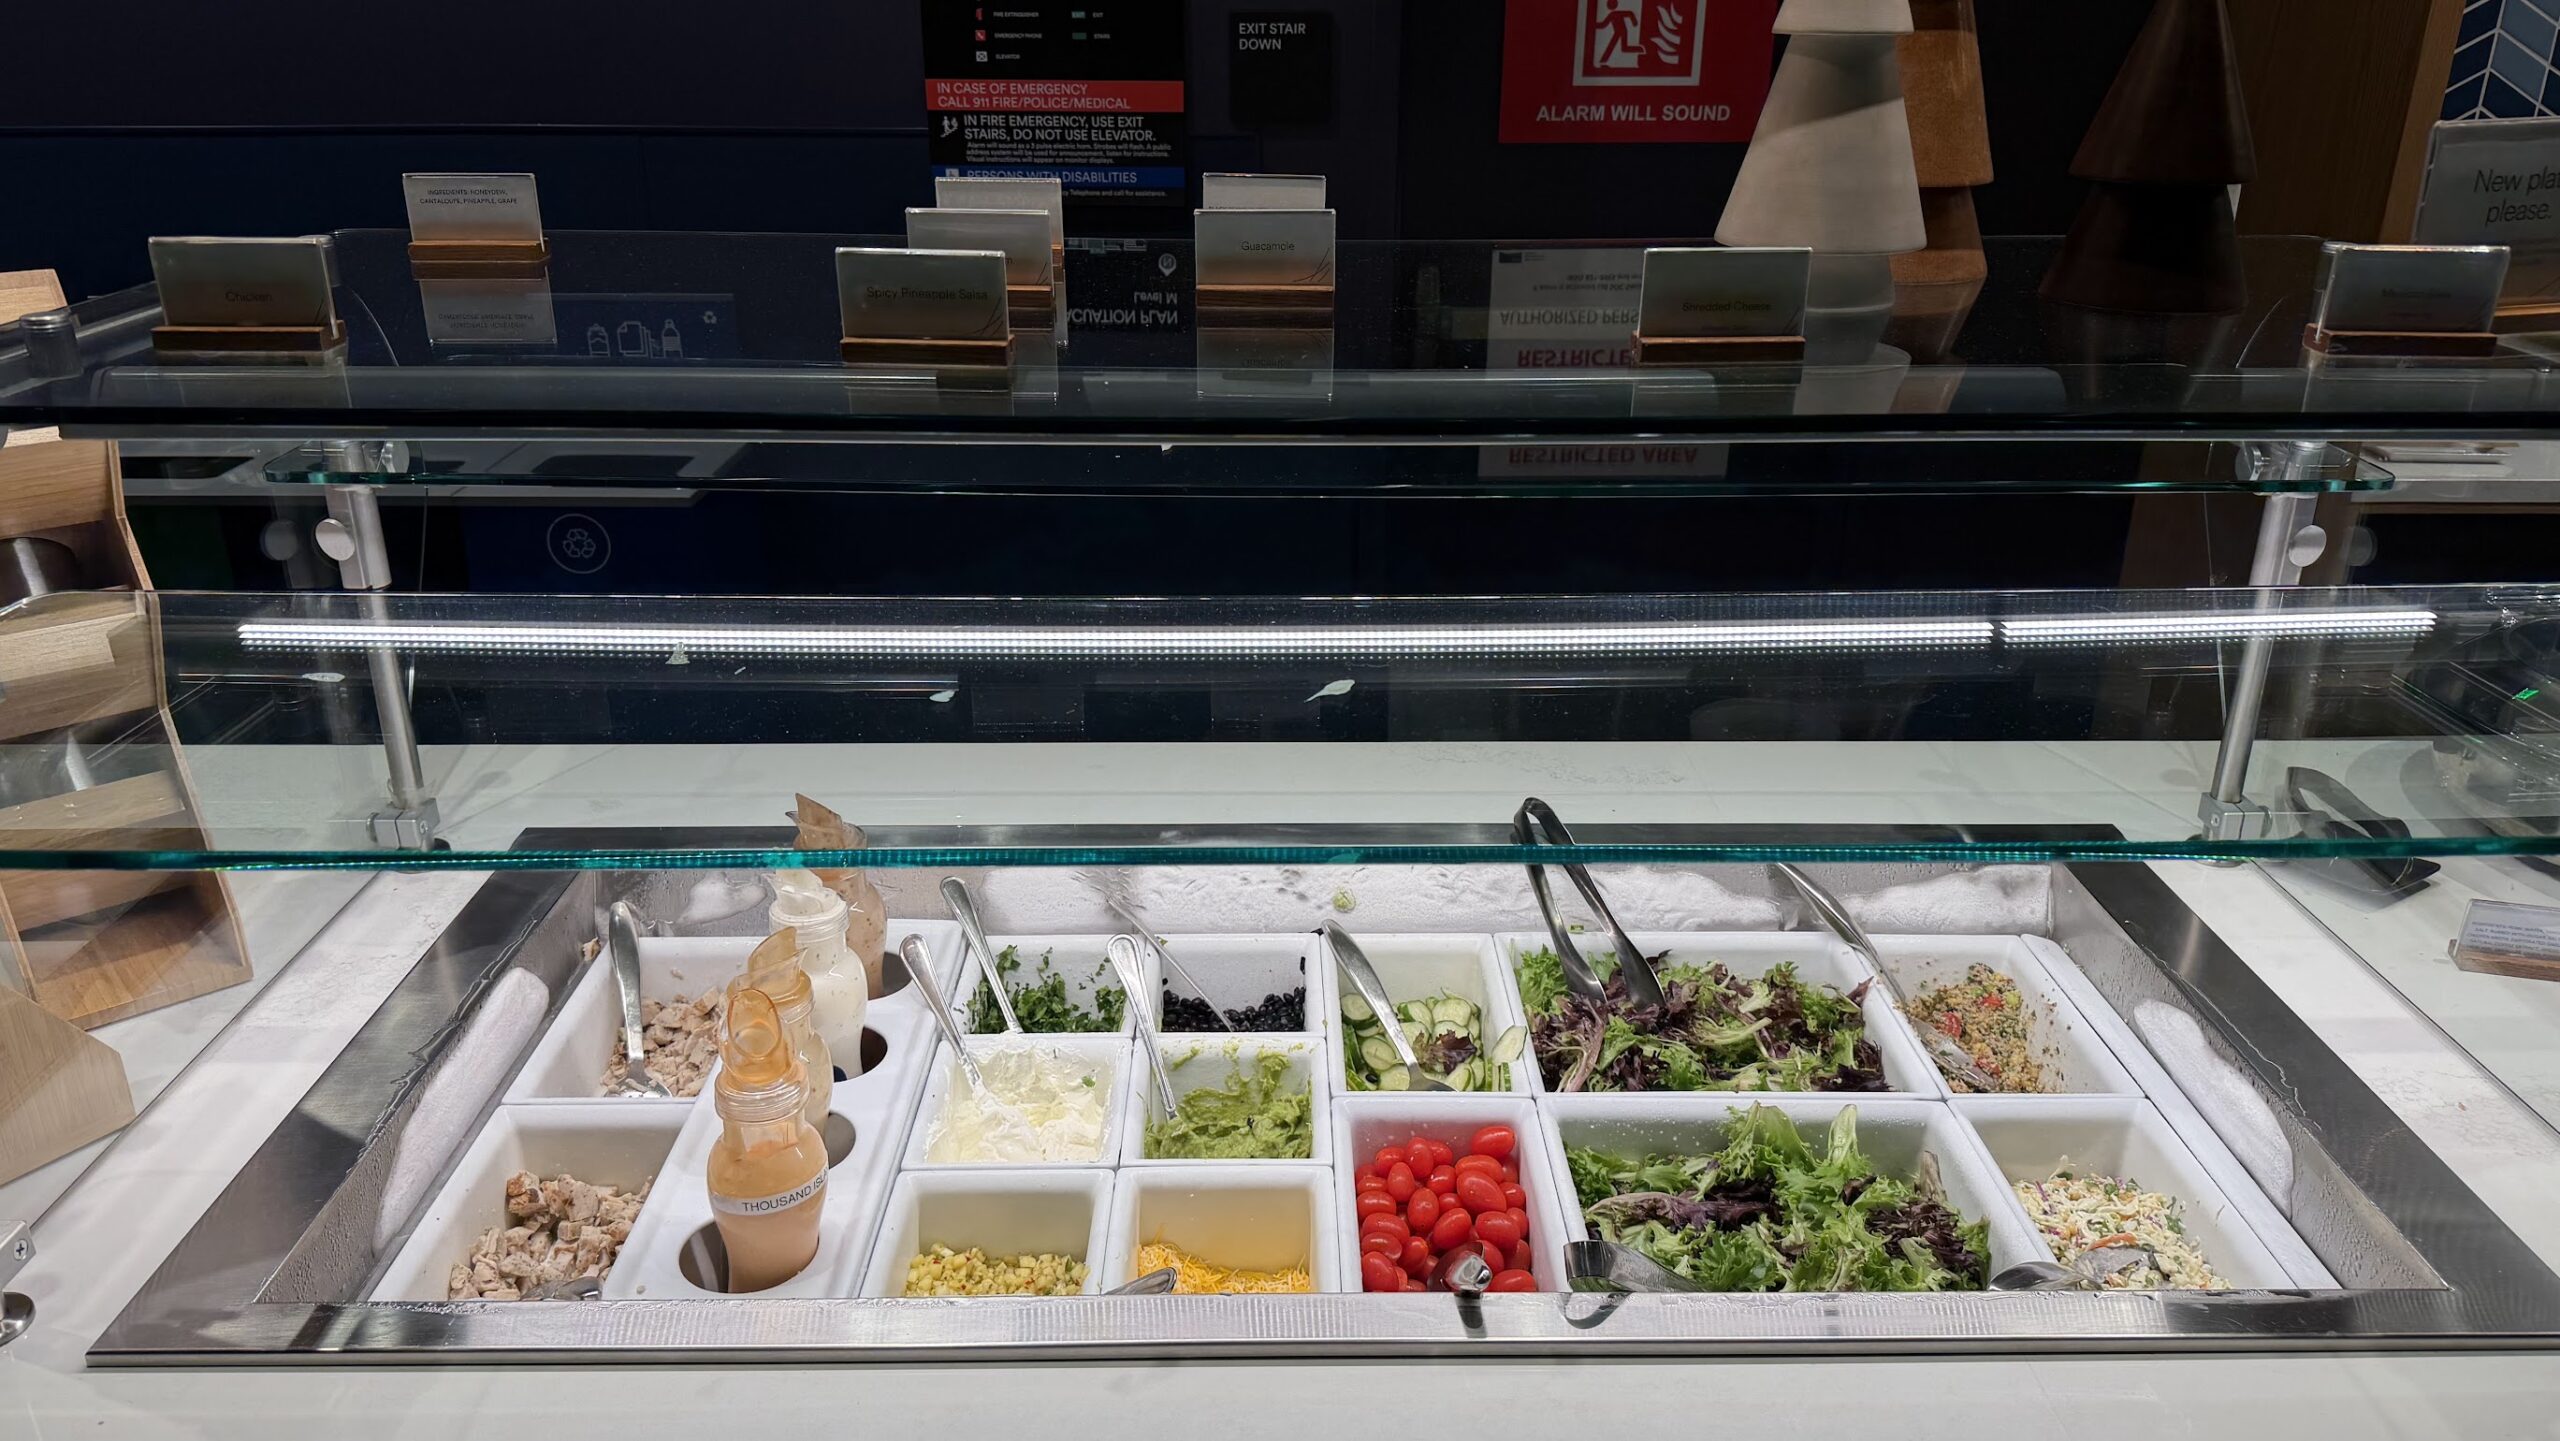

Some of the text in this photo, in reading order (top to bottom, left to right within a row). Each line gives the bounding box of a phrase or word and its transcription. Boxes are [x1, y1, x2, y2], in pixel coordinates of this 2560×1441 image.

[1238, 22, 1306, 35] EXIT STAIR
[1238, 38, 1282, 51] DOWN
[937, 82, 1088, 96] IN CASE OF EMERGENCY
[938, 96, 1131, 110] CALL 911 FIRE/POLICE/MEDICAL
[1536, 104, 1731, 122] ALARM WILL SOUND
[964, 114, 1144, 129] IN FIRE EMERGENCY, USE EXIT
[964, 128, 1157, 142] STAIRS, DO NOT USE ELEVATOR.
[967, 170, 1024, 178] PERSONS
[1062, 171, 1138, 184] DISABILITIES
[2473, 169, 2524, 193] New
[2485, 198, 2552, 228] please.
[1241, 241, 1295, 252] Guacamole
[225, 290, 273, 303] Chicken
[866, 286, 988, 301] Spicy Pineapple Salsa
[1681, 300, 1772, 312] Shredded Cheese
[741, 1166, 829, 1212] THOUSAND ISLA
